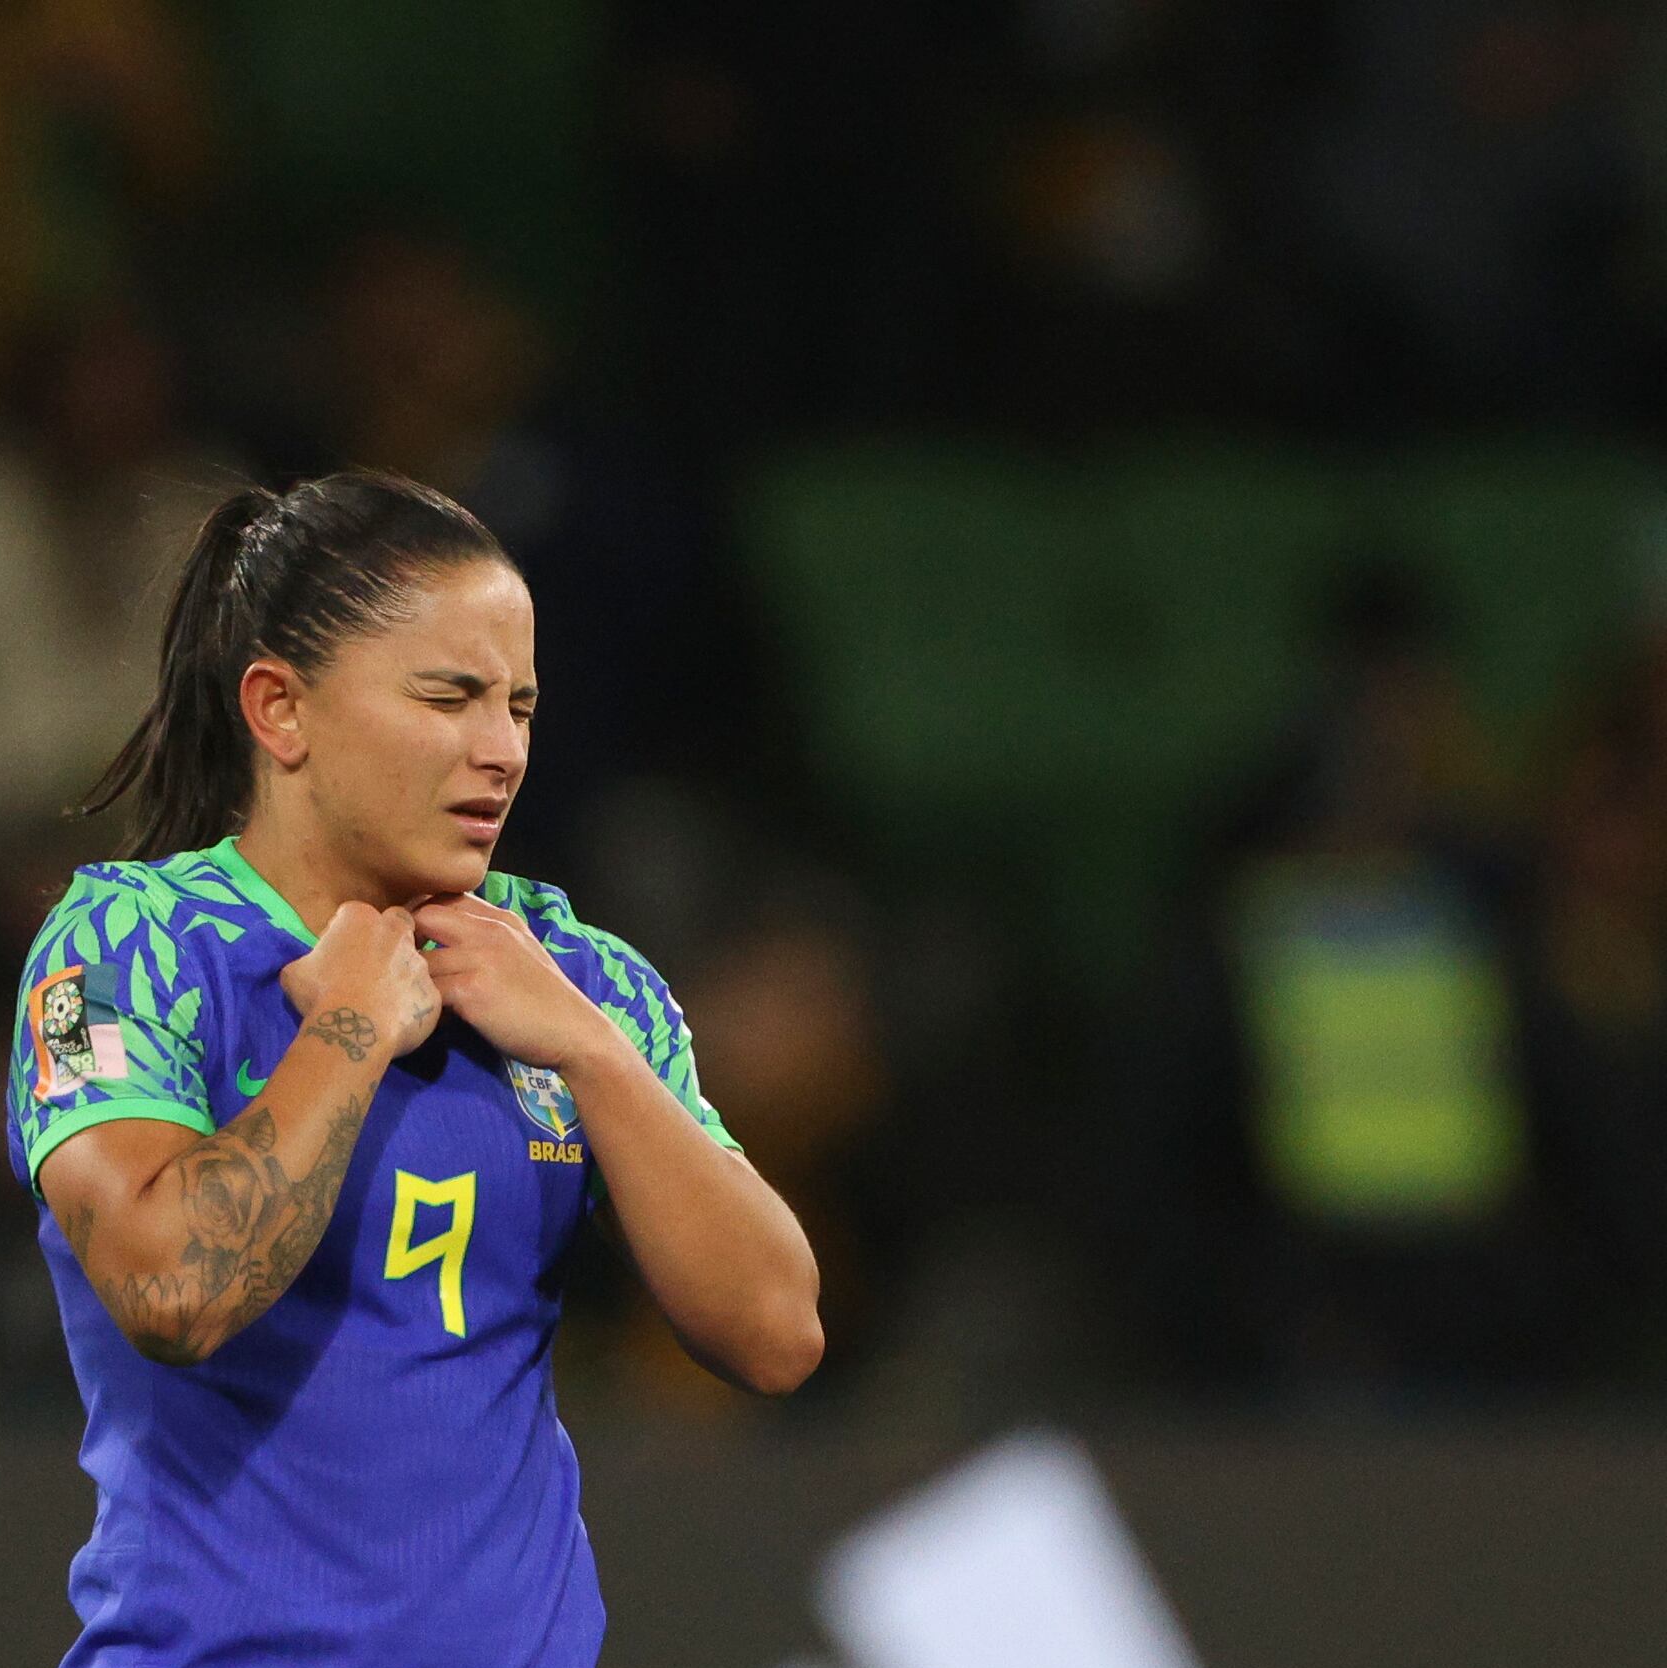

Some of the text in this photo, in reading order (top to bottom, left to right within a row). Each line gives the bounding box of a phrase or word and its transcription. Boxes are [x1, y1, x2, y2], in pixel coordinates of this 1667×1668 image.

[528, 1076, 552, 1090] CBF
[529, 1140, 583, 1163] BRASIL
[384, 1170, 477, 1337] 9
